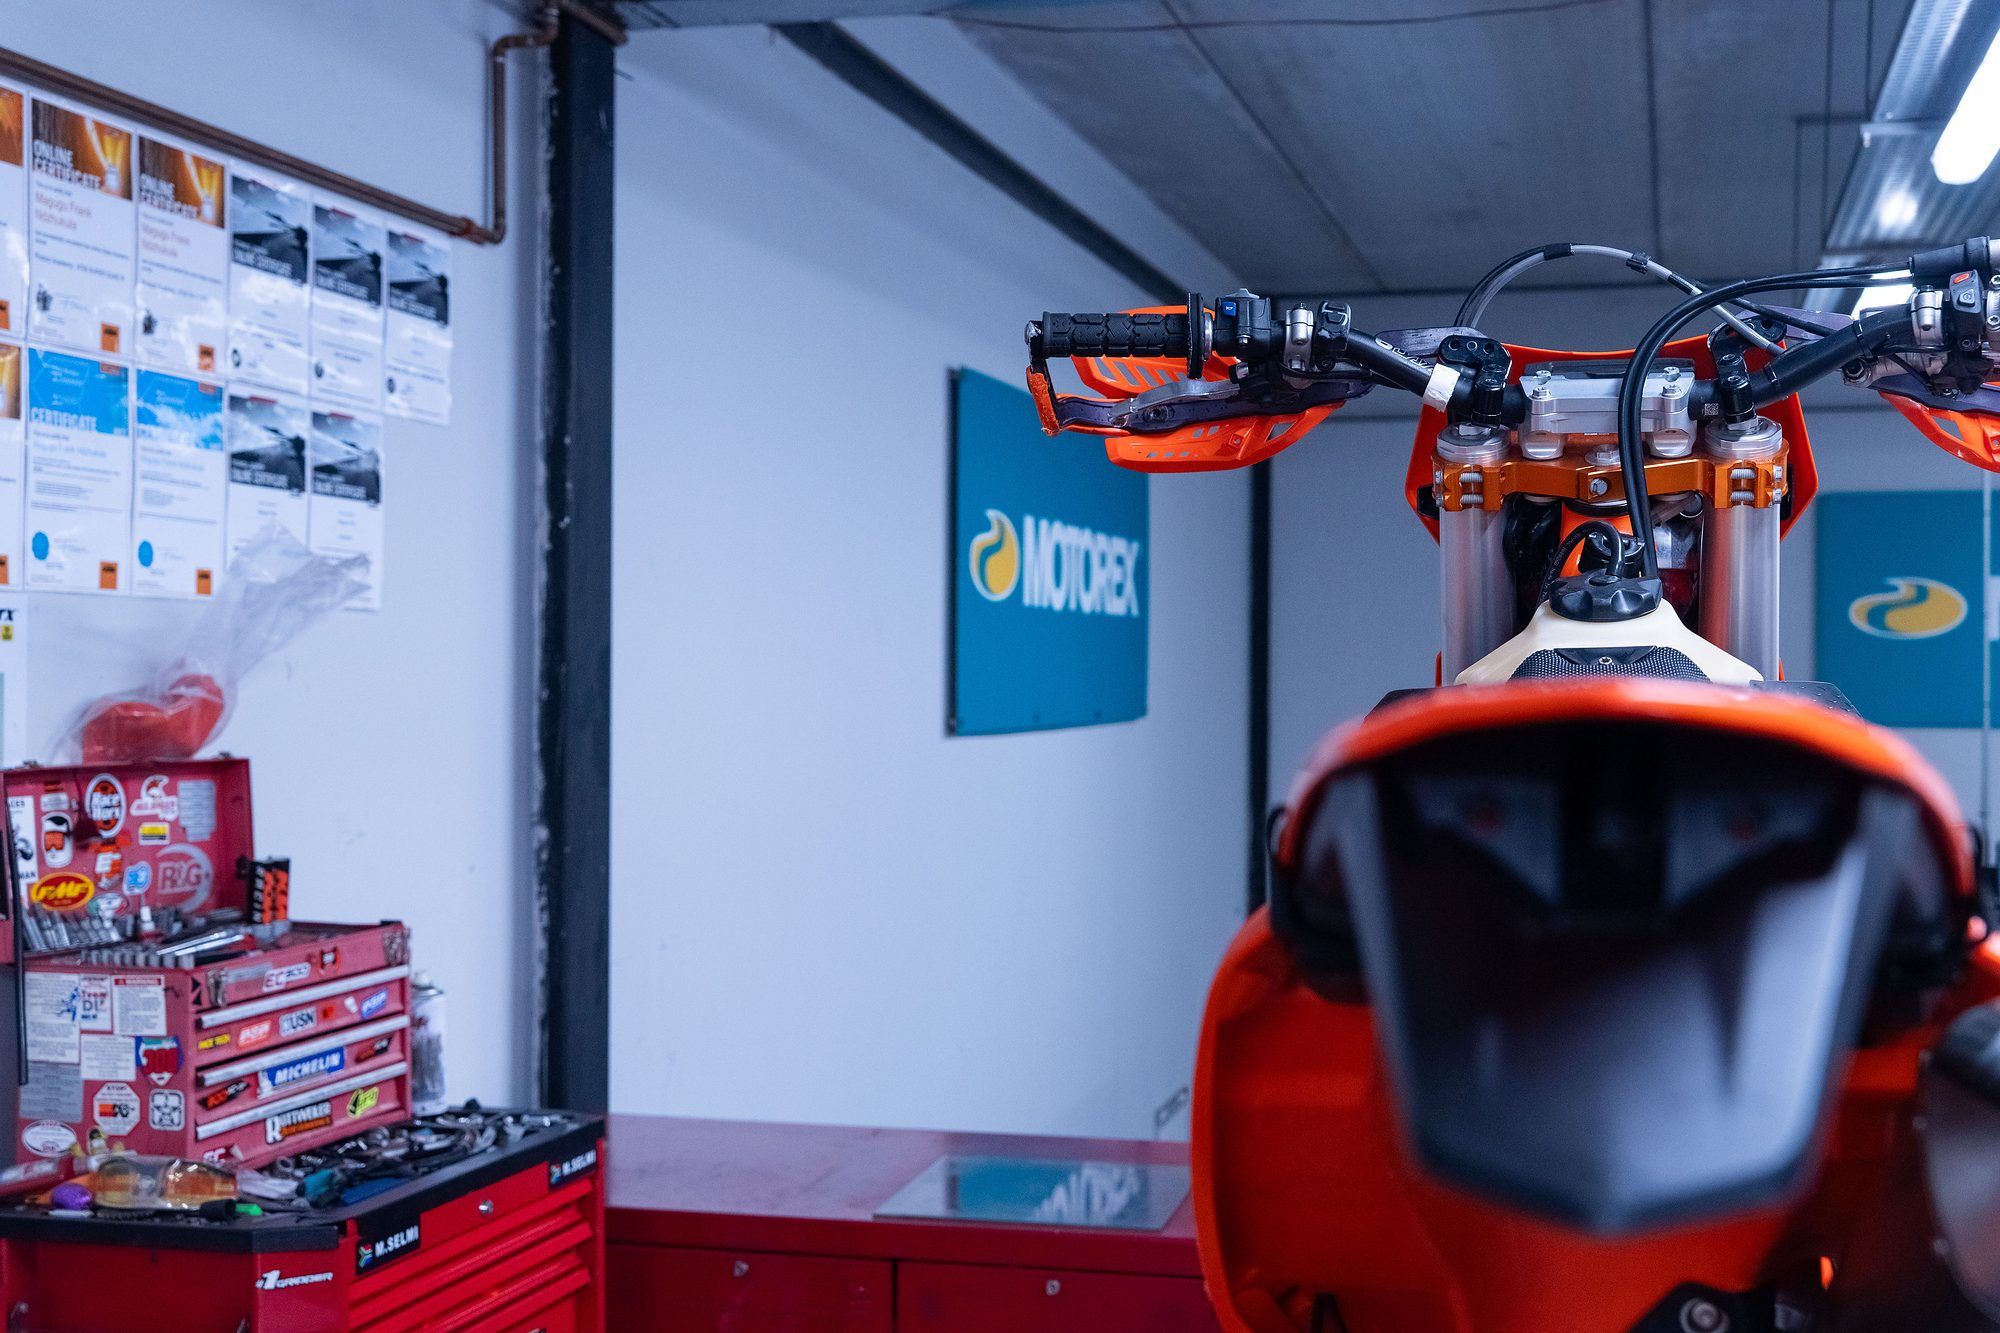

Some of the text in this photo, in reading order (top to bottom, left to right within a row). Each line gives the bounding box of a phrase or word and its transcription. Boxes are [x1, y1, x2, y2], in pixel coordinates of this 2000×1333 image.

[1023, 515, 1140, 616] MOTOREX
[37, 881, 89, 901] FMF
[275, 1051, 341, 1085] MICHELIN
